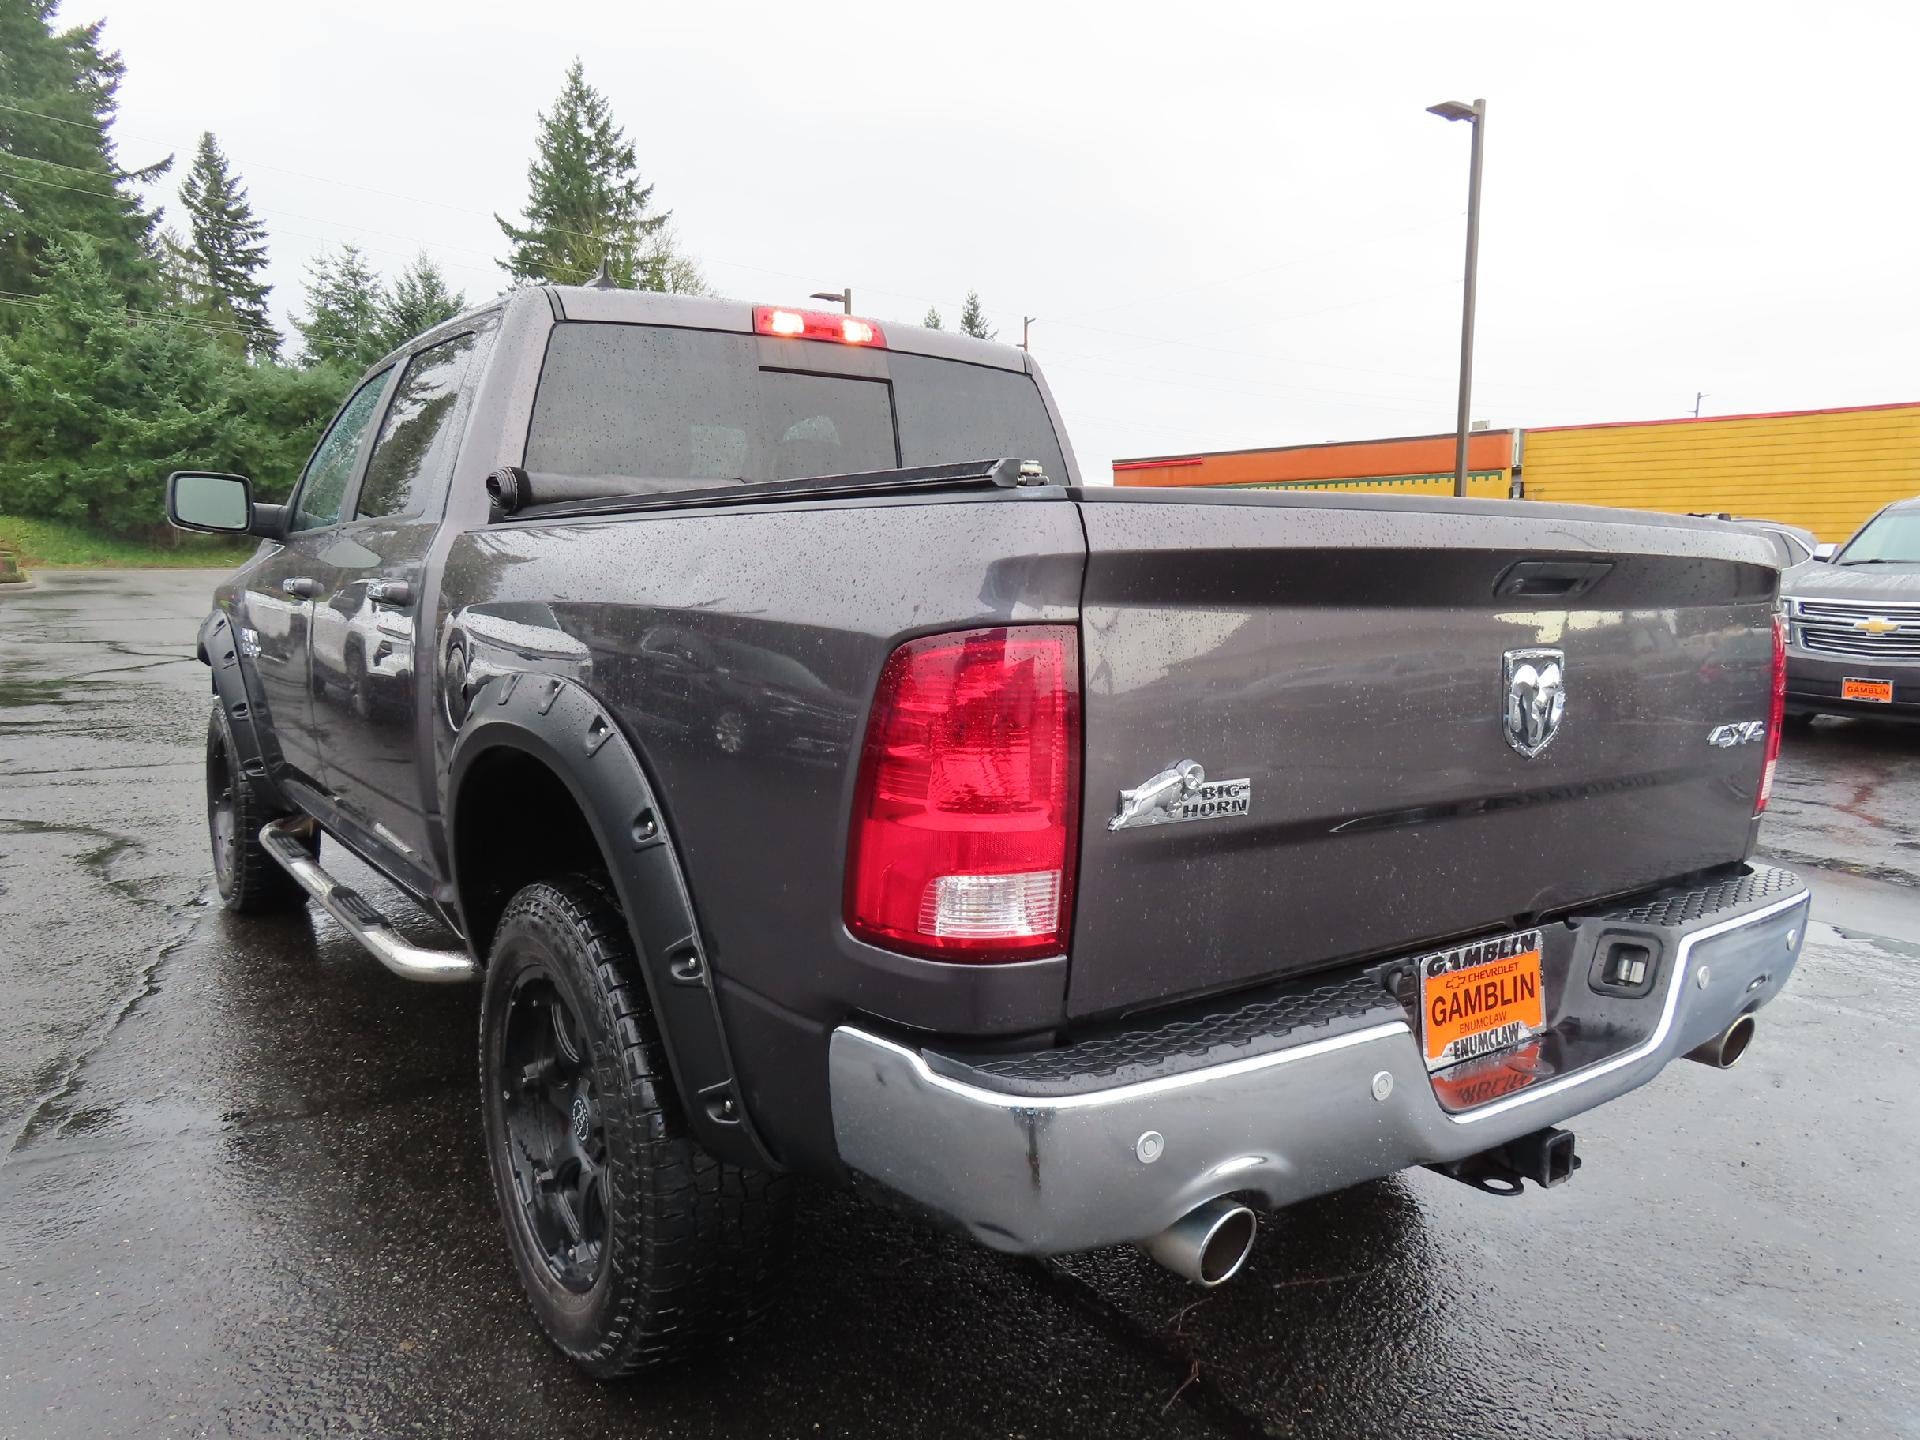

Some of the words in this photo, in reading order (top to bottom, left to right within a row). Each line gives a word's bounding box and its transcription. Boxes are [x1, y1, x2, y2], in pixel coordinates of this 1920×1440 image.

[1847, 686, 1889, 695] GAMBLIN
[1201, 784, 1240, 800] BIG
[1182, 799, 1247, 818] HORN
[1427, 933, 1537, 978] GAMBLIN
[1468, 962, 1519, 982] CHEVROLET
[1431, 972, 1535, 1026] GAMBLIN
[1459, 1011, 1507, 1034] ENUMCLAW
[1453, 1022, 1520, 1060] ENUMCLAW
